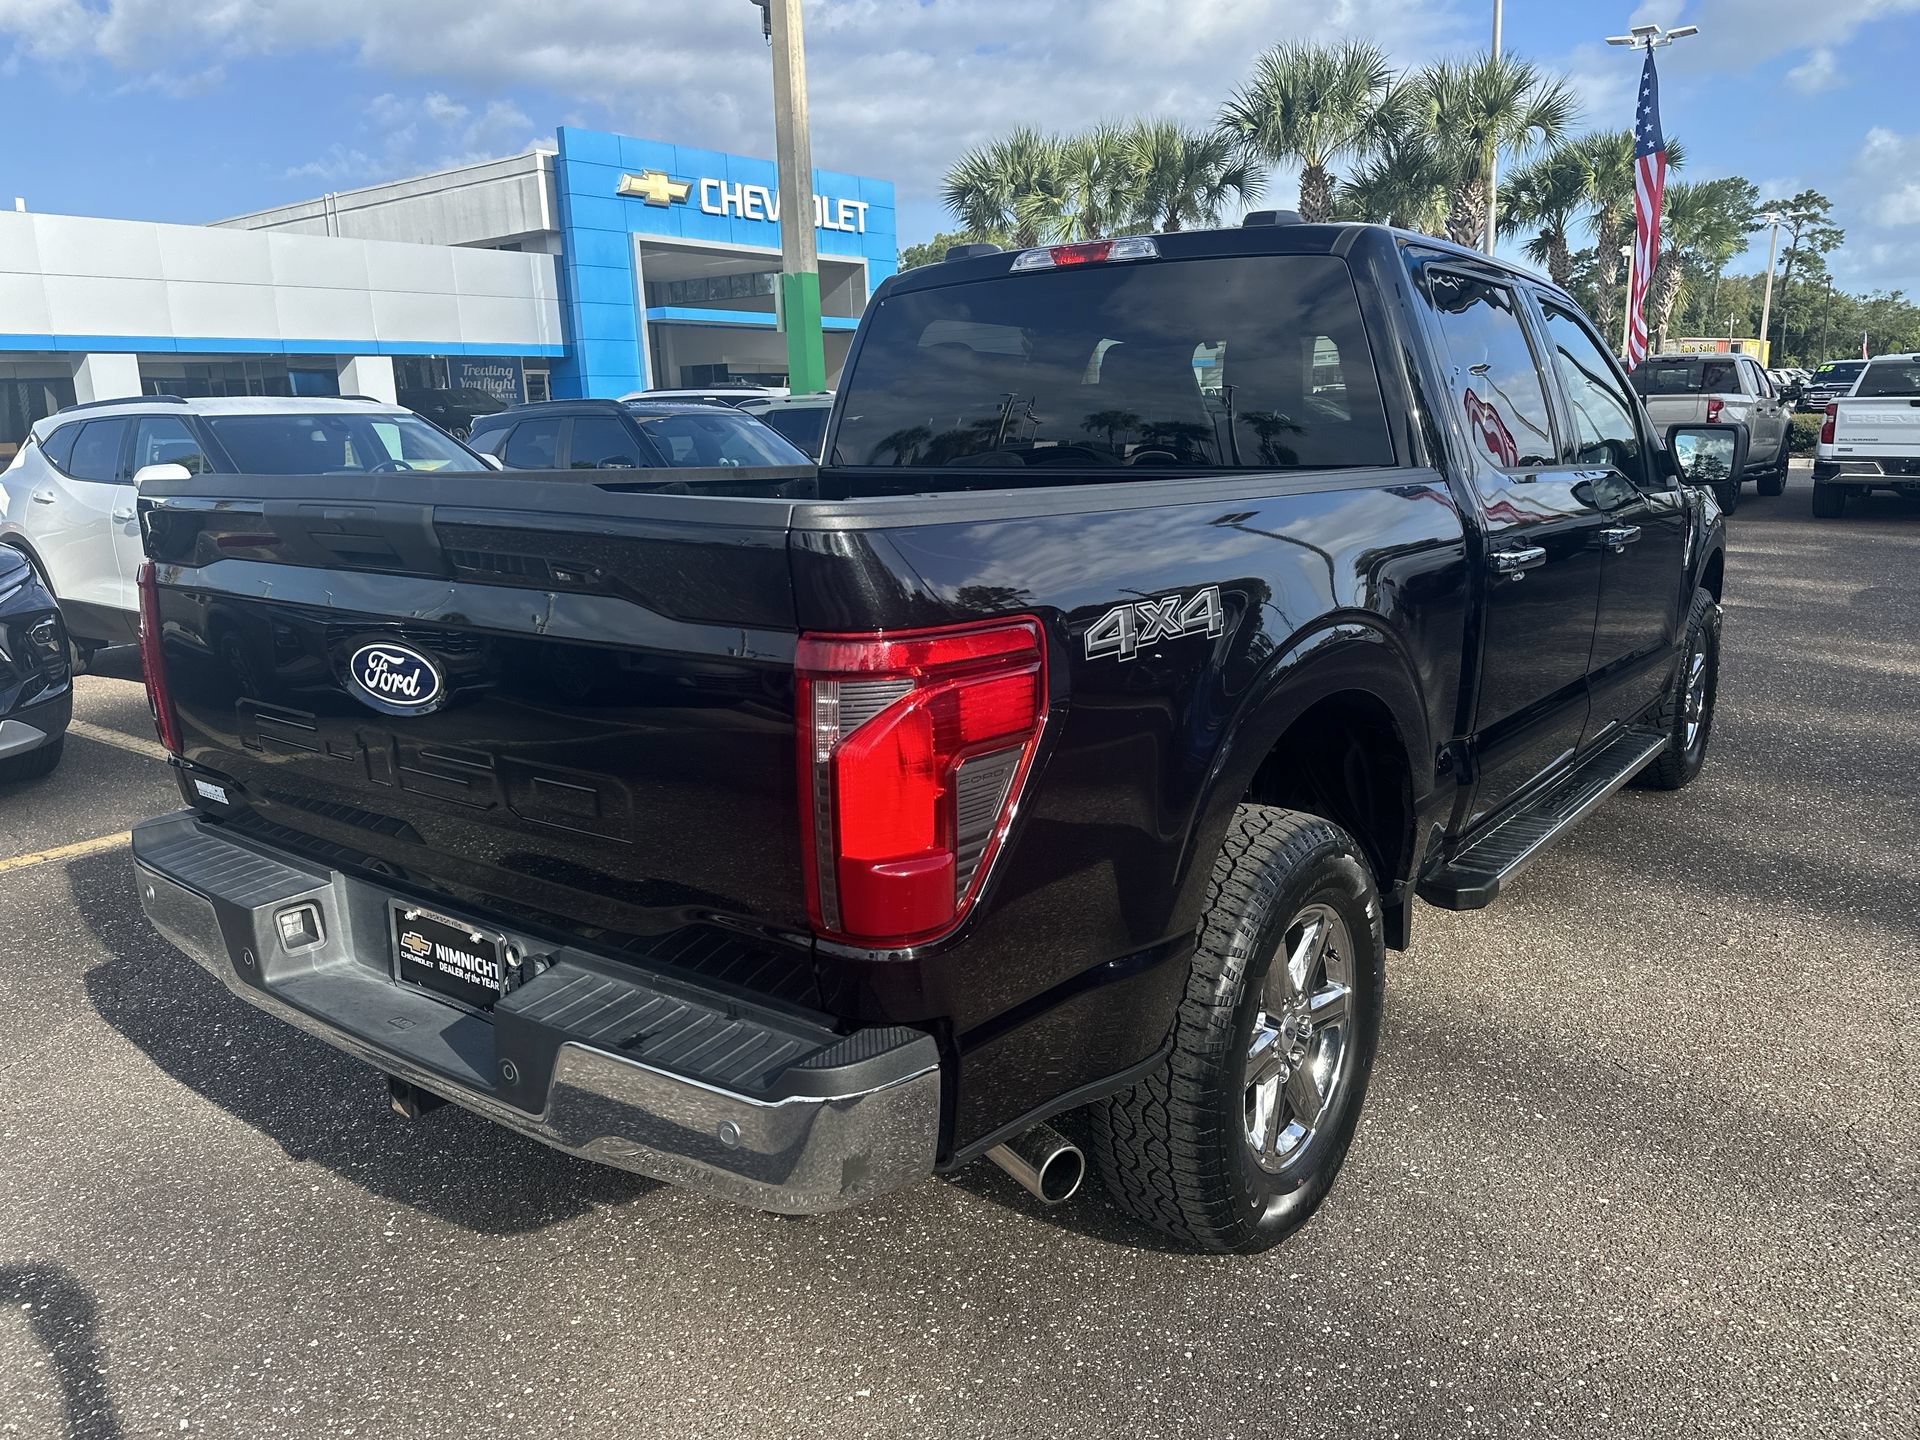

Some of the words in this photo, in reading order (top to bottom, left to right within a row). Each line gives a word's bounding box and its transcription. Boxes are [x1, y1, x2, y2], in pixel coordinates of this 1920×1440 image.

[700, 178, 869, 233] CHEVLET
[1681, 345, 1696, 353] Auto
[1699, 341, 1716, 352] Sales
[461, 364, 513, 380] Treating
[460, 377, 481, 390] You
[483, 377, 515, 393] Right
[364, 650, 421, 697] Ford
[234, 697, 635, 845] F-150
[959, 769, 1005, 785] FORD
[400, 951, 434, 969] CHEVROLET
[435, 943, 499, 980] NIMNICHT
[439, 961, 464, 979] DEALER
[464, 972, 472, 984] of
[471, 974, 481, 985] the
[480, 976, 500, 991] YEAR
